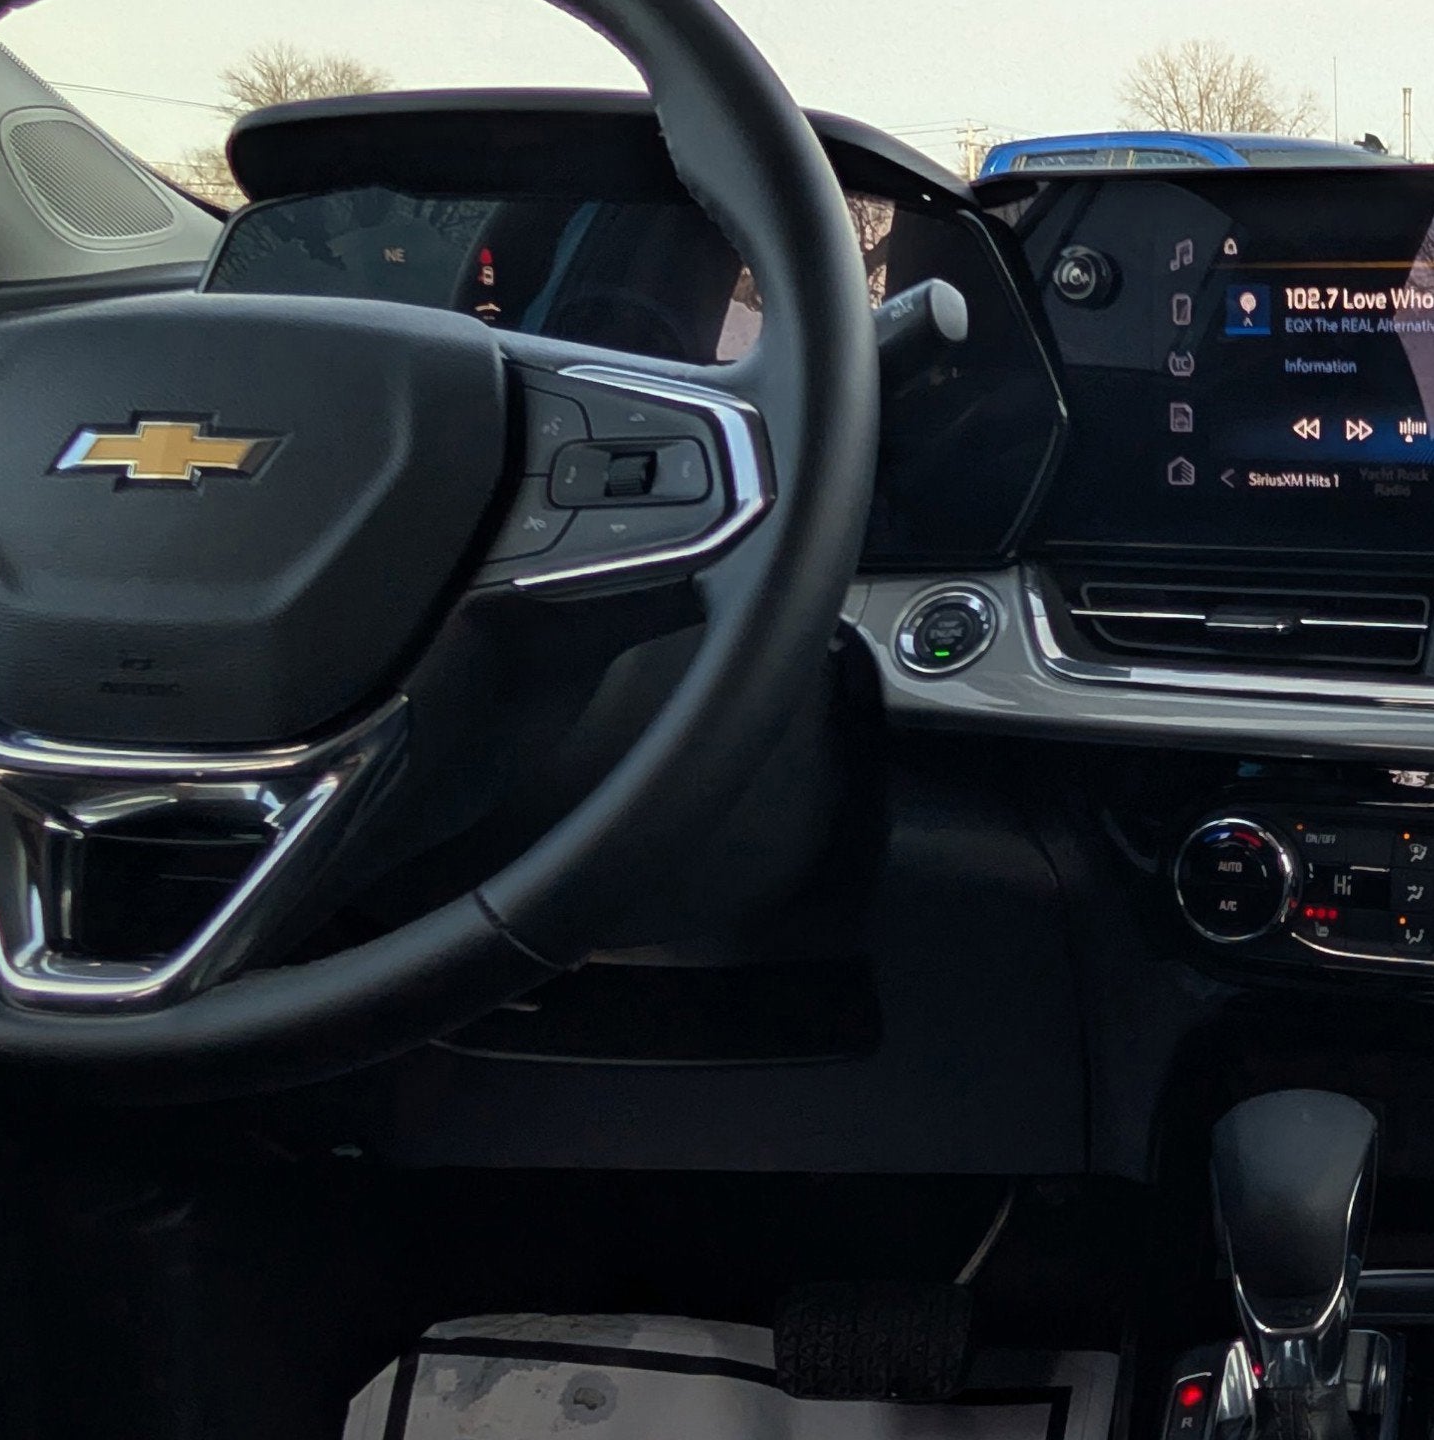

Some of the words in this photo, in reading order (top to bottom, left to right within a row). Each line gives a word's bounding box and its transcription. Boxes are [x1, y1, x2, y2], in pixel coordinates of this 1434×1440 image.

[383, 247, 407, 263] NE
[1285, 287, 1338, 310] 102.7
[1343, 287, 1387, 310] Love
[1390, 288, 1434, 310] Who
[1284, 317, 1313, 334] EQX
[1315, 317, 1338, 333] The
[1341, 317, 1374, 333] REAL
[1285, 358, 1357, 374] Information
[1248, 472, 1303, 487] SiriusXM
[1306, 473, 1331, 488] Hits
[1334, 473, 1340, 488] 1
[1305, 834, 1337, 845] ON/OFF
[1218, 861, 1243, 874] AUTO
[1333, 875, 1352, 896] Hi
[1219, 899, 1237, 912] A/C
[1181, 1416, 1193, 1430] R
